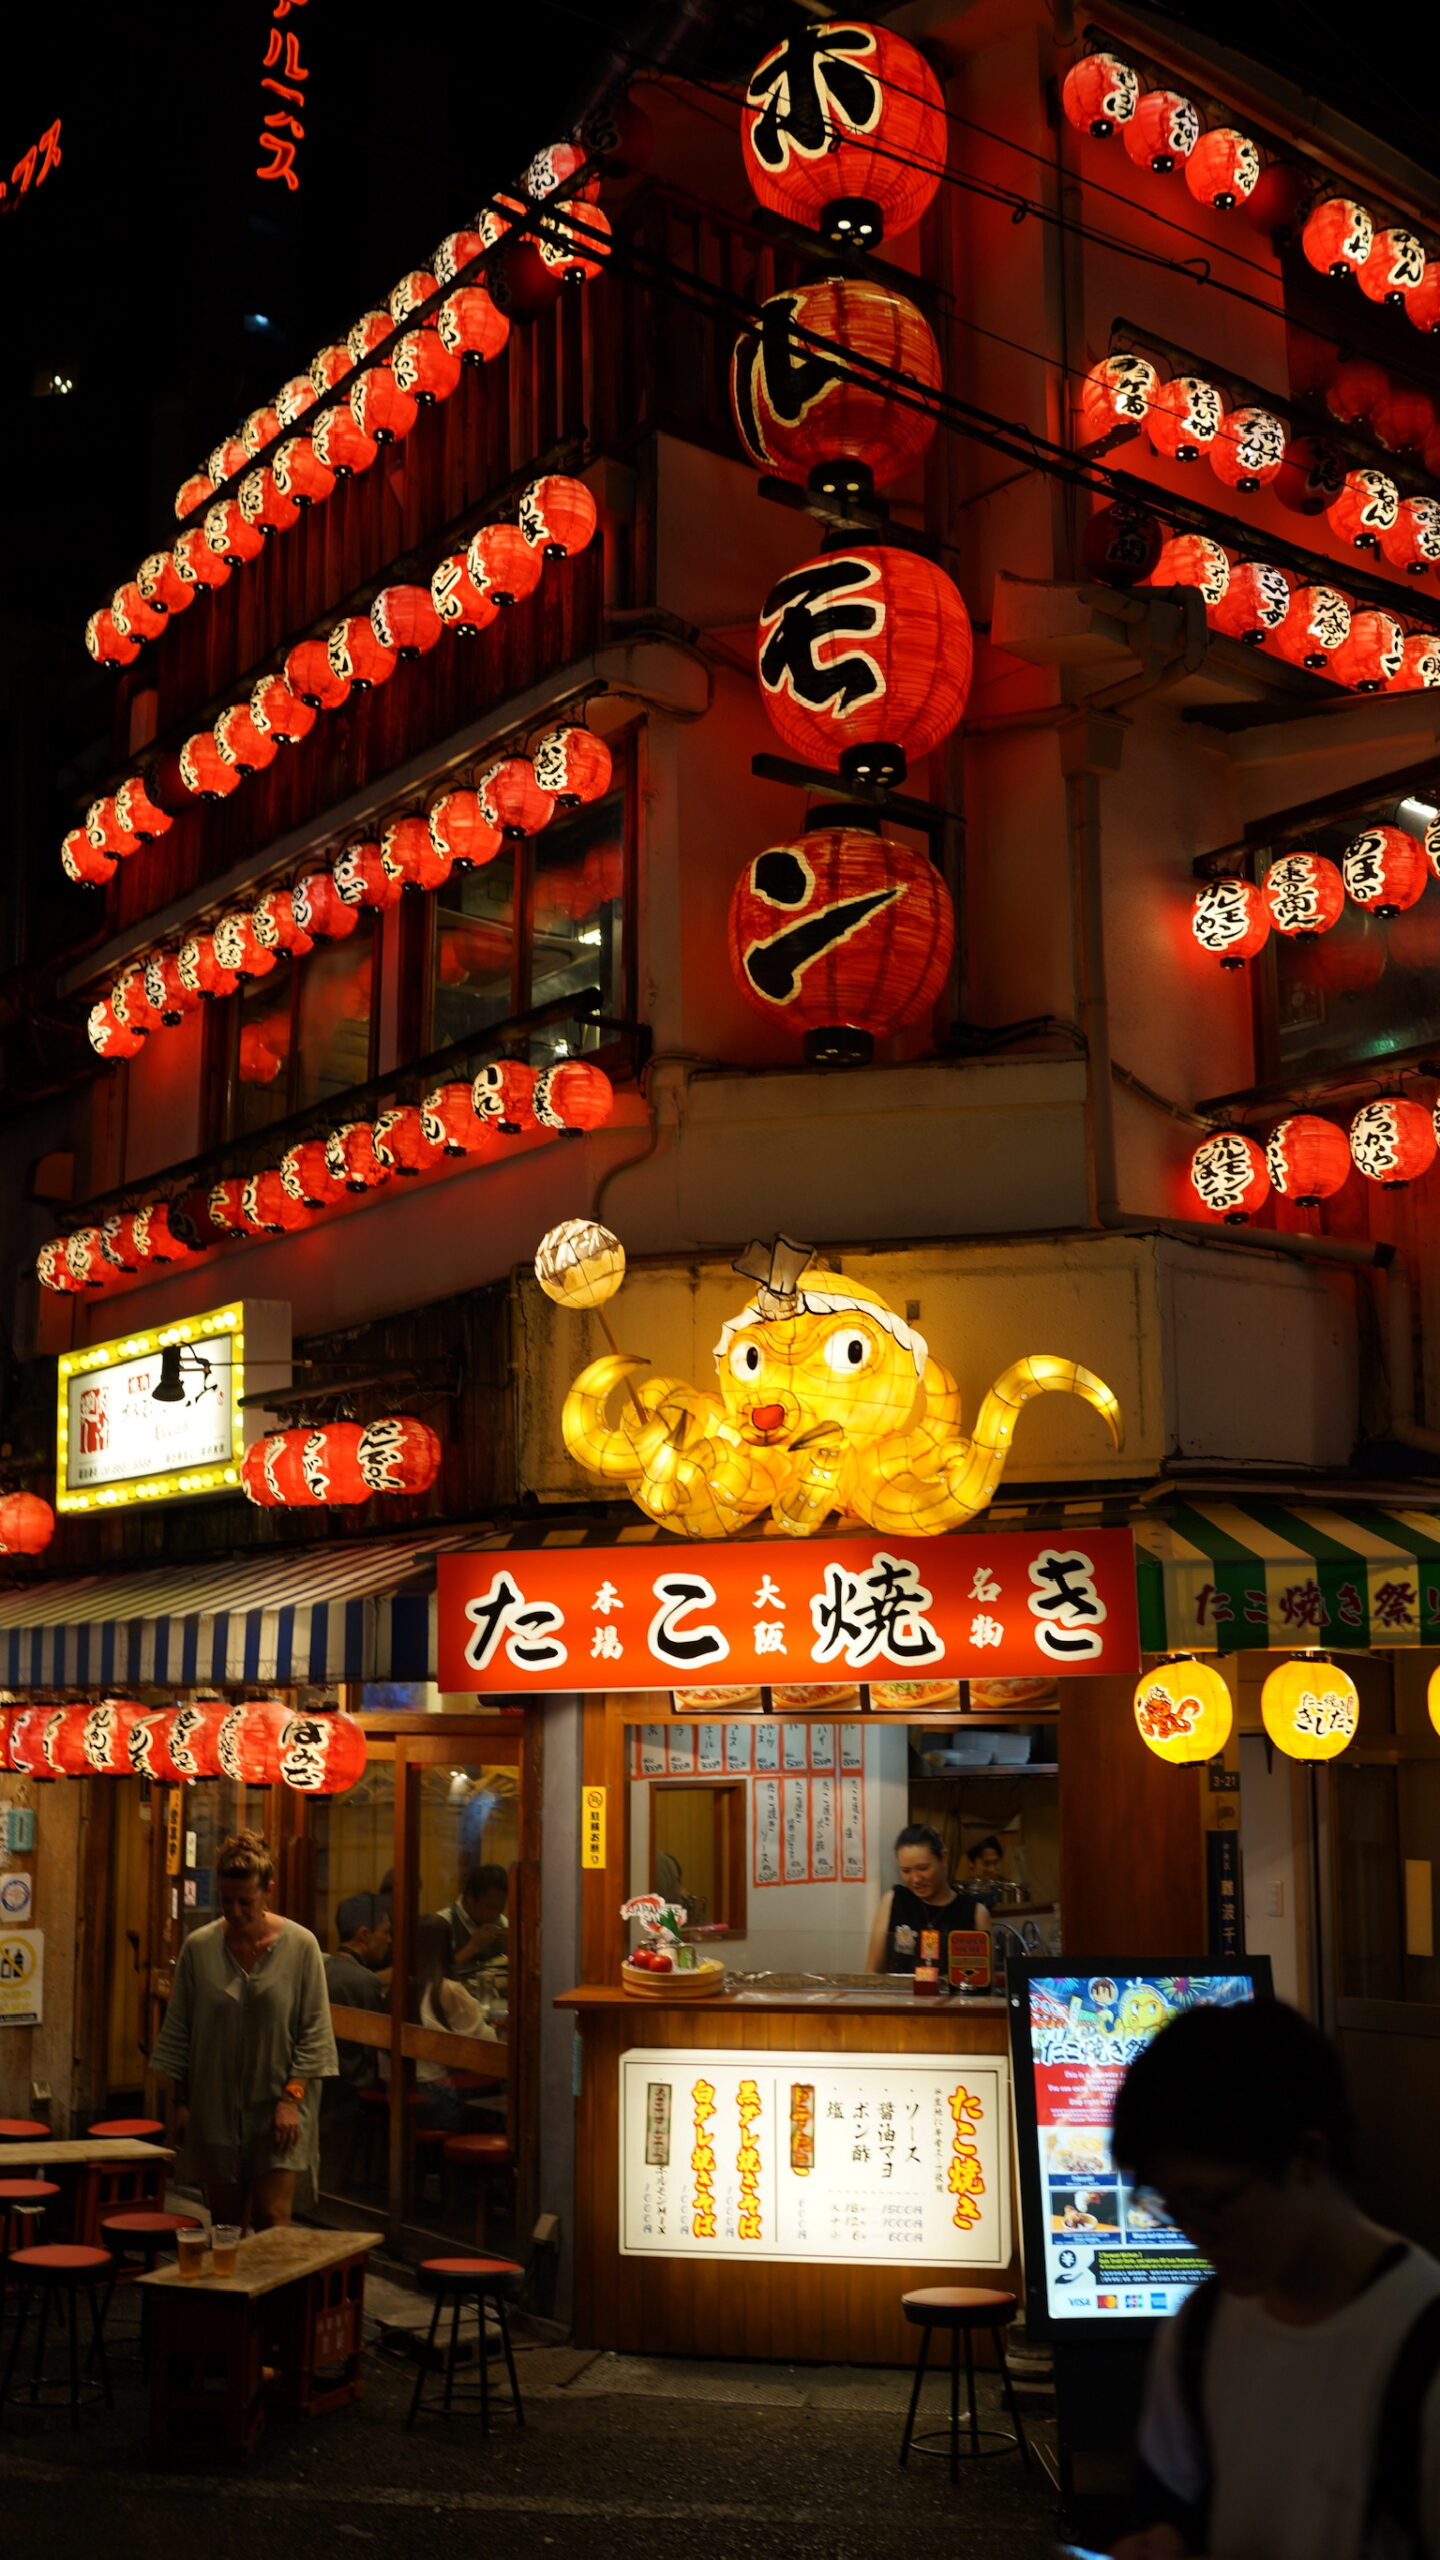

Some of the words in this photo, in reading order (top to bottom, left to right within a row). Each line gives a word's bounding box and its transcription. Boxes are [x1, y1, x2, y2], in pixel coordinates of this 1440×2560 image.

[464, 1551, 1108, 1671] たこ焼き
[752, 1574, 788, 1656] 大阪
[967, 1566, 1004, 1650] 名物
[691, 2079, 717, 2239] 白ダレ焼きそば
[948, 2085, 985, 2230] たこ焼き
